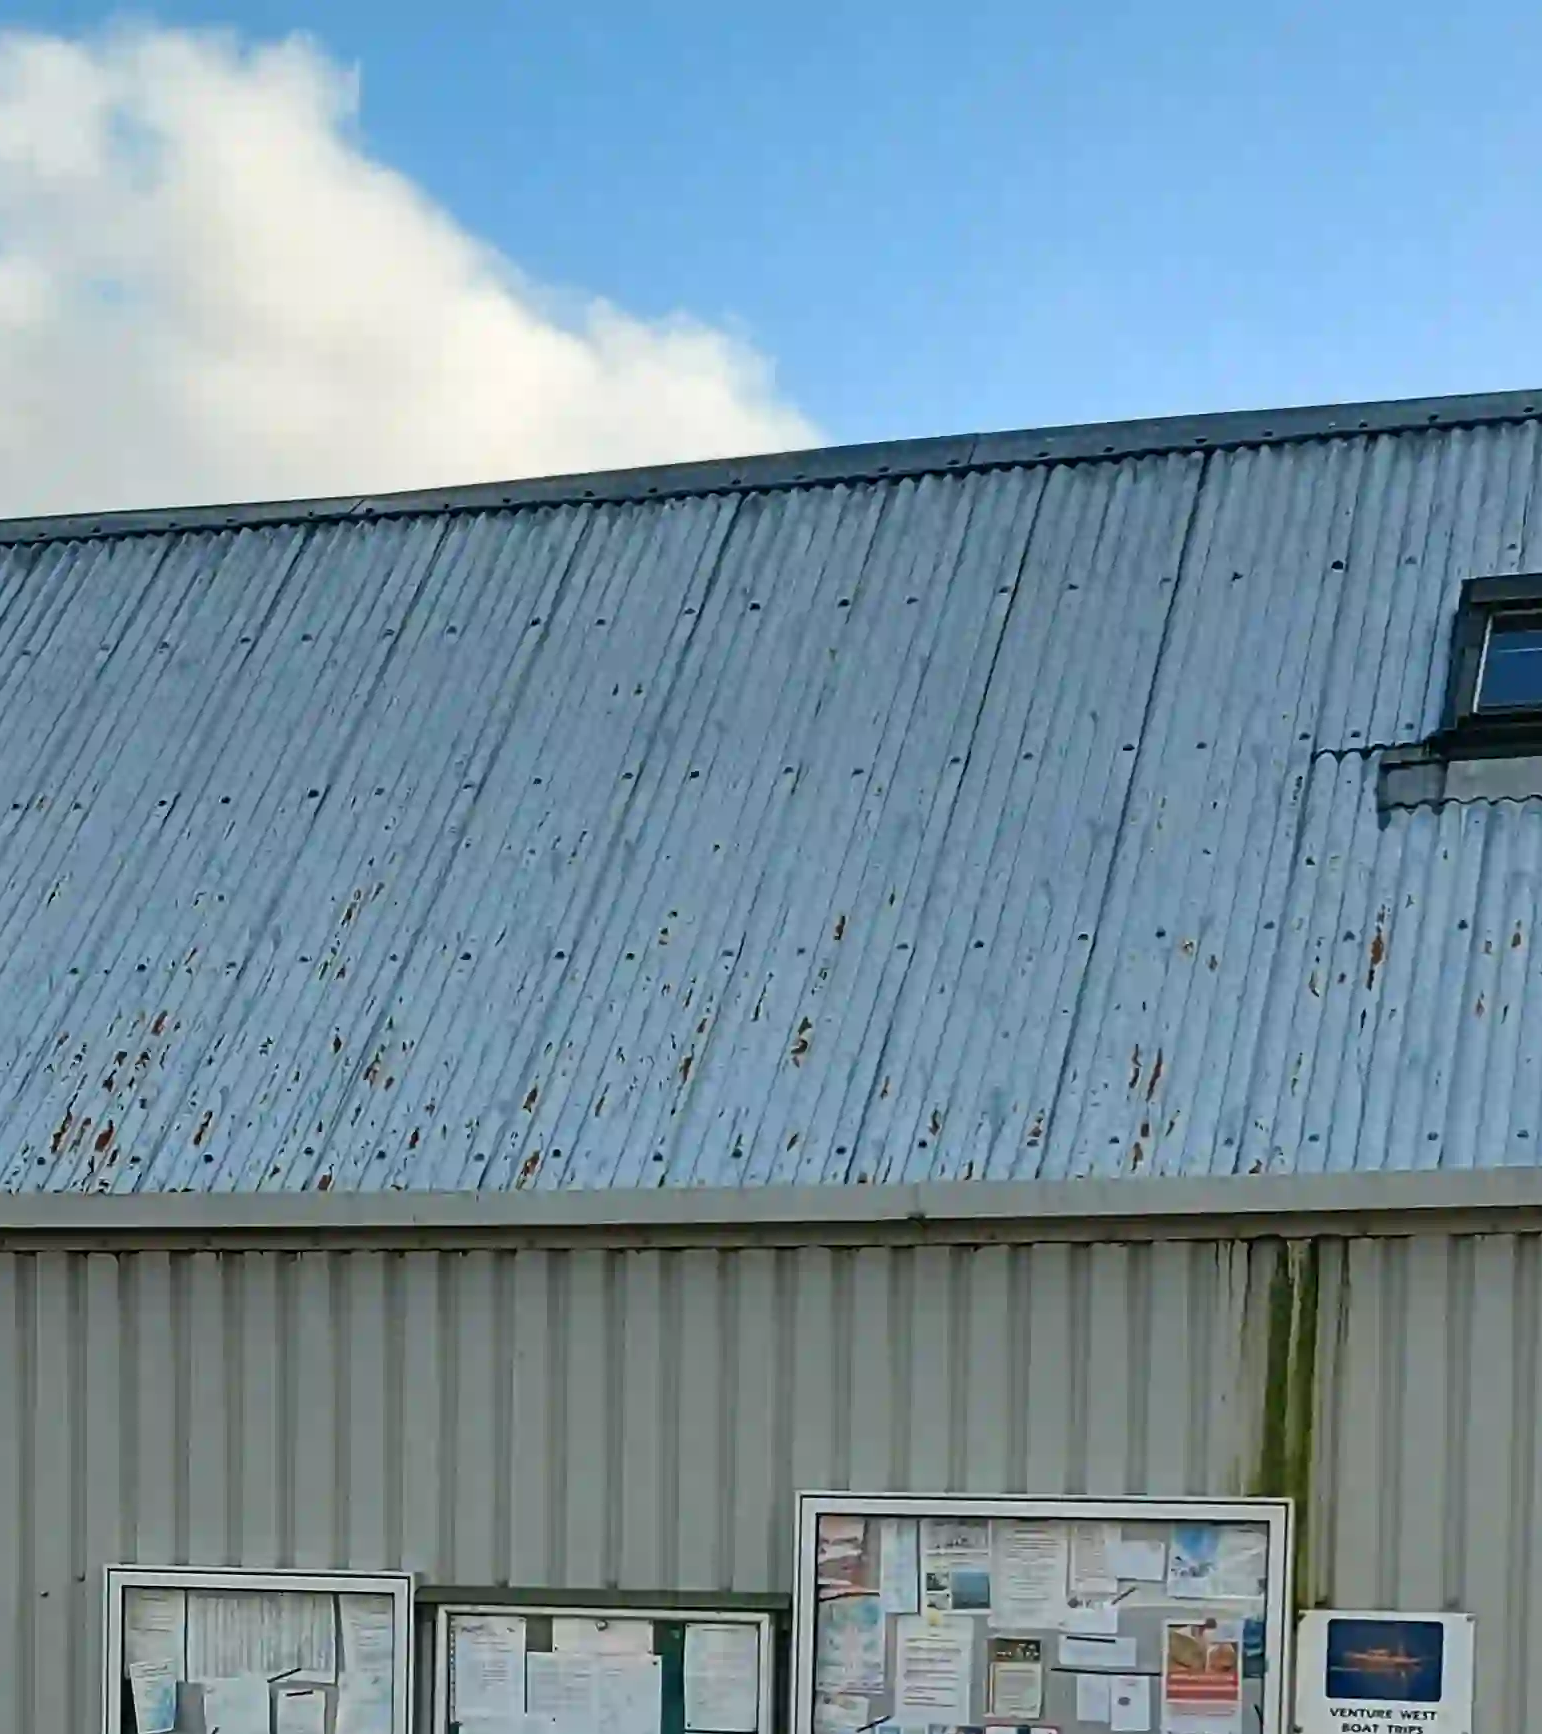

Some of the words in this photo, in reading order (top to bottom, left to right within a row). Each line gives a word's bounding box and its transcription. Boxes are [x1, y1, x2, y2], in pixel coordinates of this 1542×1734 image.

[1329, 1708, 1392, 1719] VENTURE
[1400, 1710, 1437, 1721] WEST
[1341, 1723, 1379, 1734] BOAT
[1388, 1725, 1424, 1734] TRIPS
